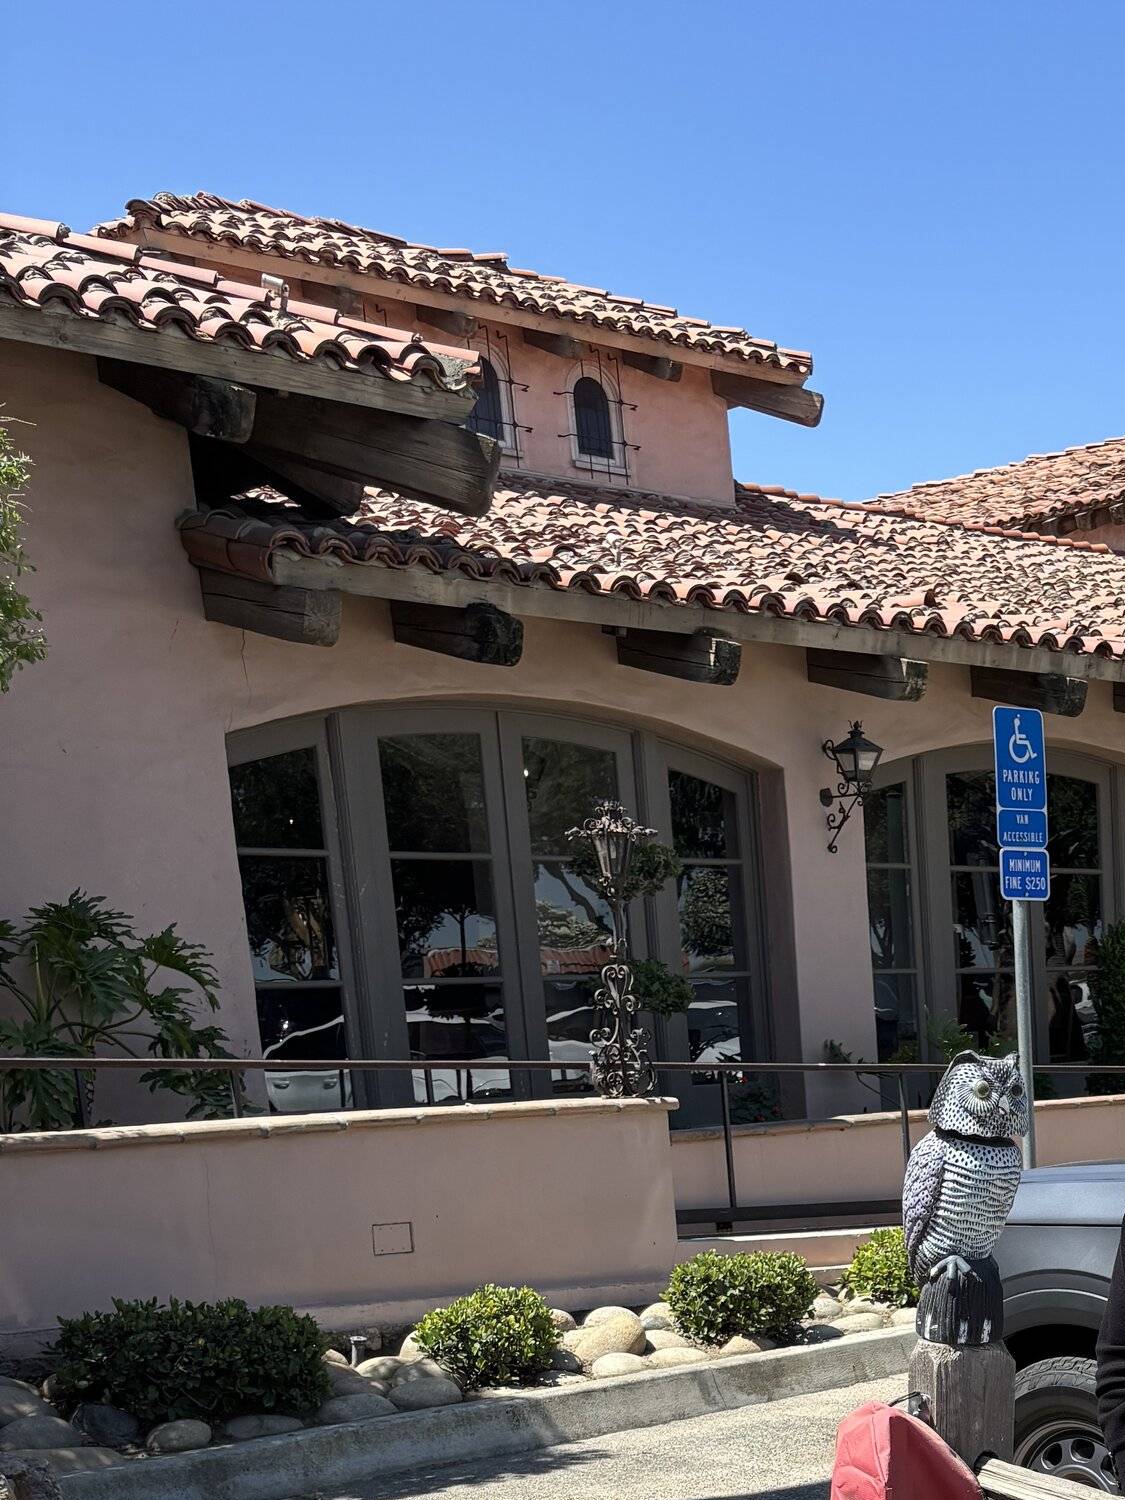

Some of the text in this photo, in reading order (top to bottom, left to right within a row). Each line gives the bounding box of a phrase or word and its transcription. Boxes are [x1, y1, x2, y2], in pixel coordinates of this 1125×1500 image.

[1003, 769, 1040, 784] PARKING
[1011, 787, 1032, 801] ONLY
[1016, 814, 1029, 824] VAN
[1003, 831, 1044, 843] ACCESSIBLE
[1009, 858, 1041, 873] MINIMUM
[1005, 876, 1046, 890] FINE $250
